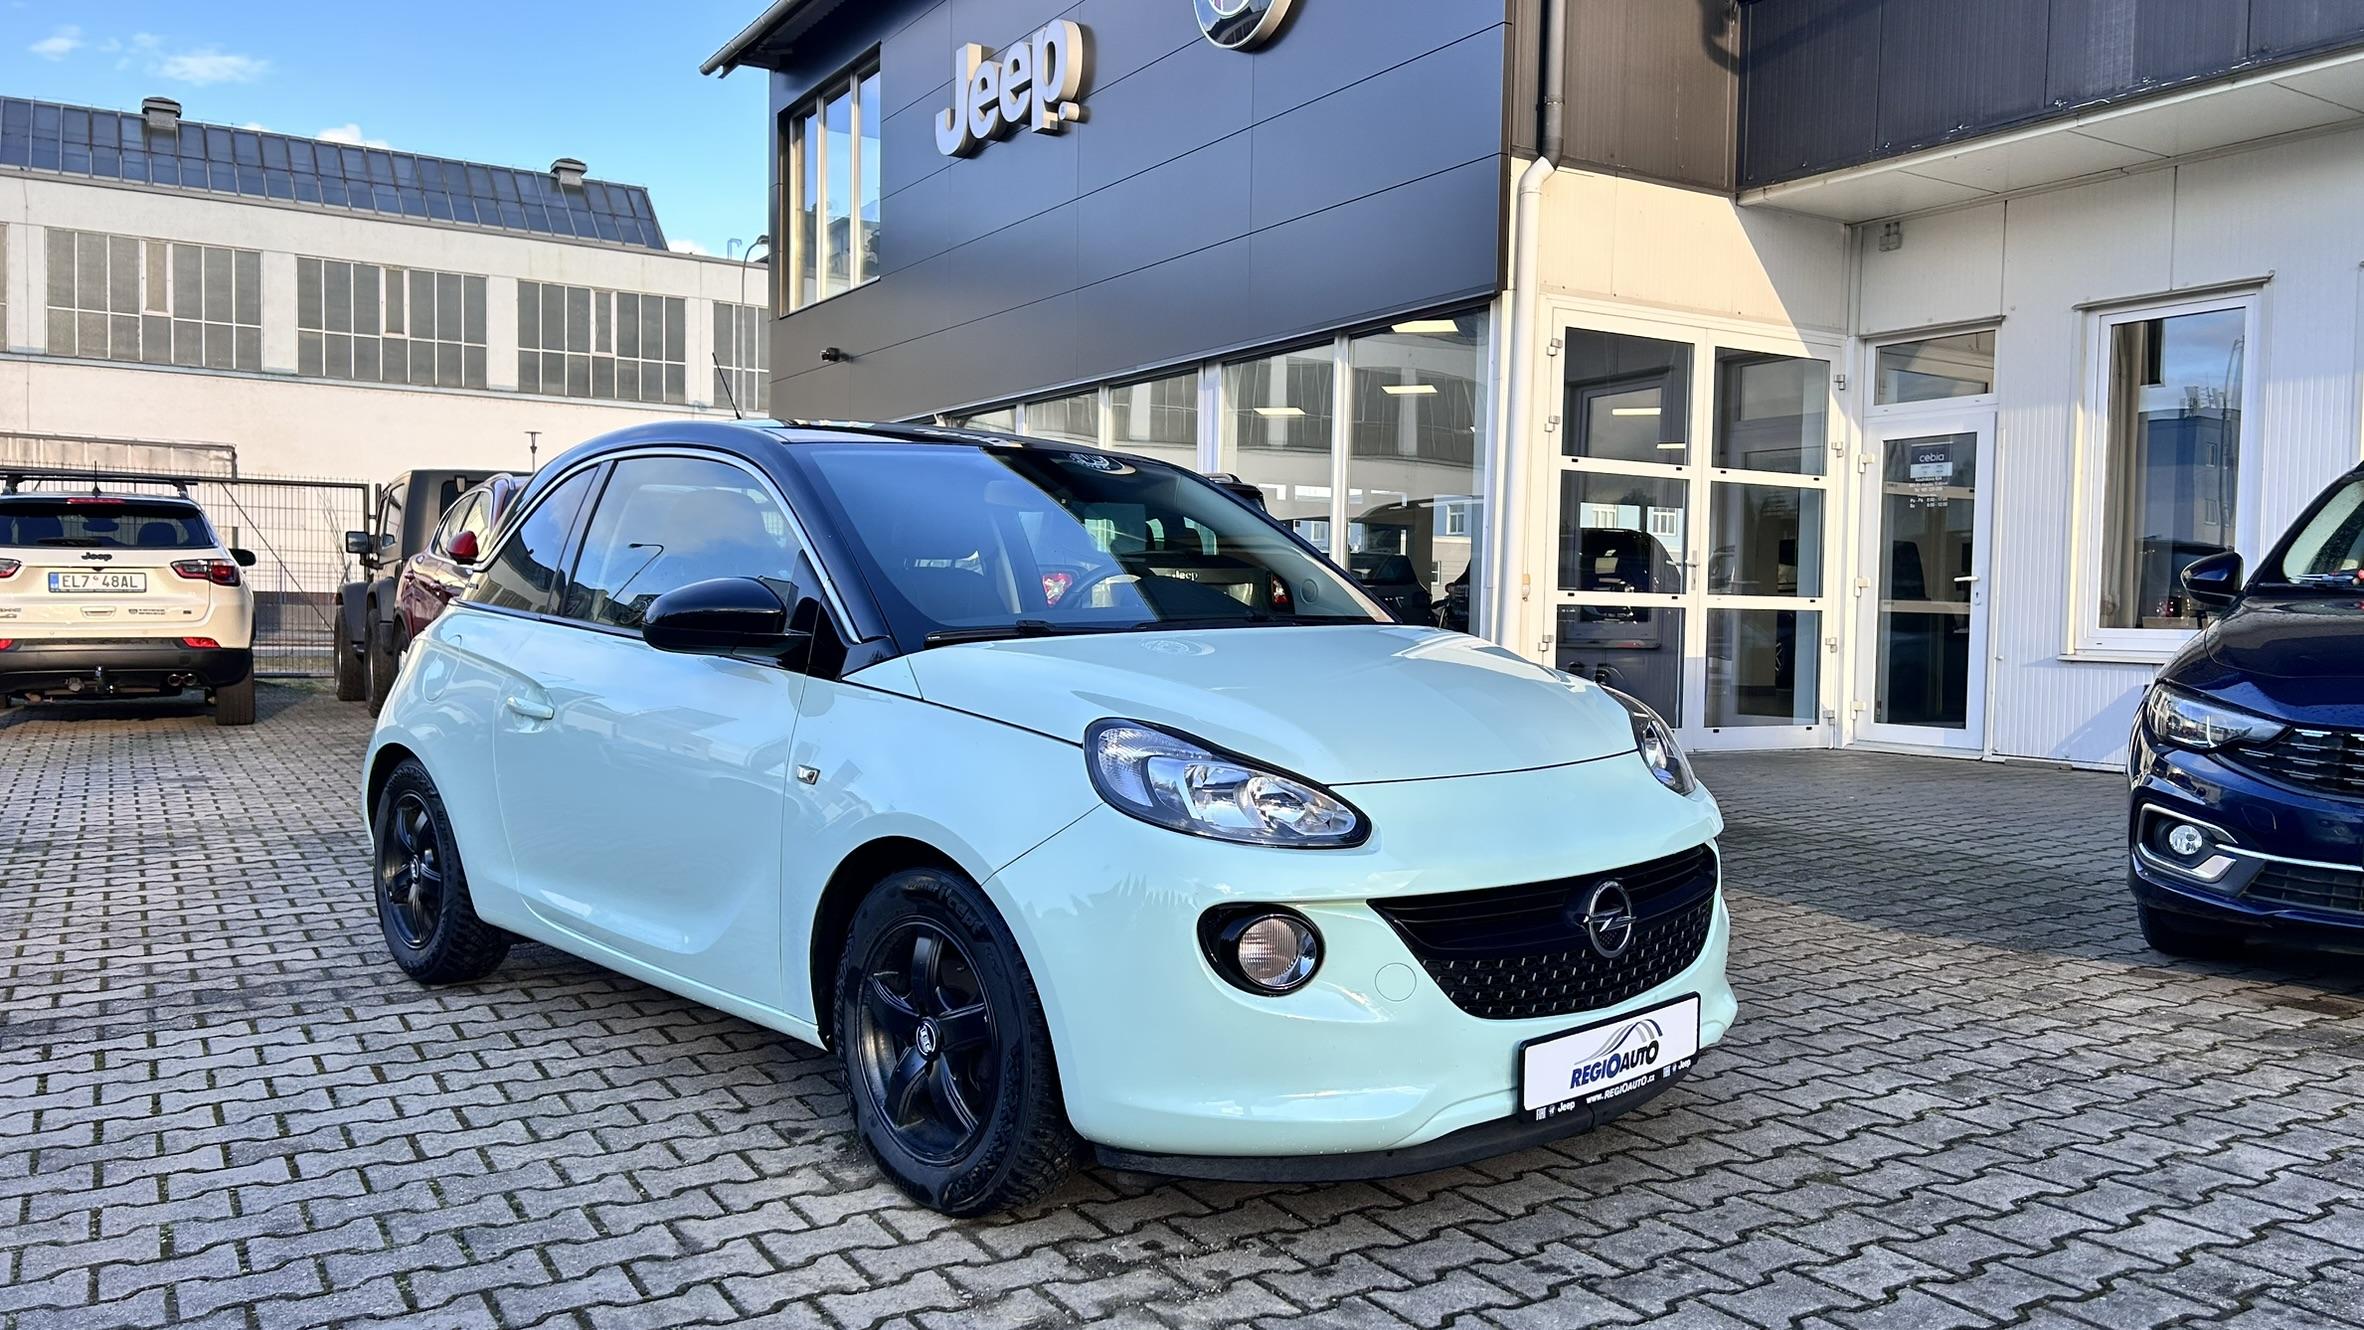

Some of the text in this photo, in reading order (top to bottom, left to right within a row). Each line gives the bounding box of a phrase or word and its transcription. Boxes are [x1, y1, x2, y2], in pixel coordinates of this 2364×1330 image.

[935, 19, 1081, 156] Jeep
[1918, 452, 1945, 463] cebia
[62, 575, 138, 588] EL7 48AL
[1569, 1039, 1660, 1090] REGIOAUTO
[1557, 1100, 1576, 1113] Jeep
